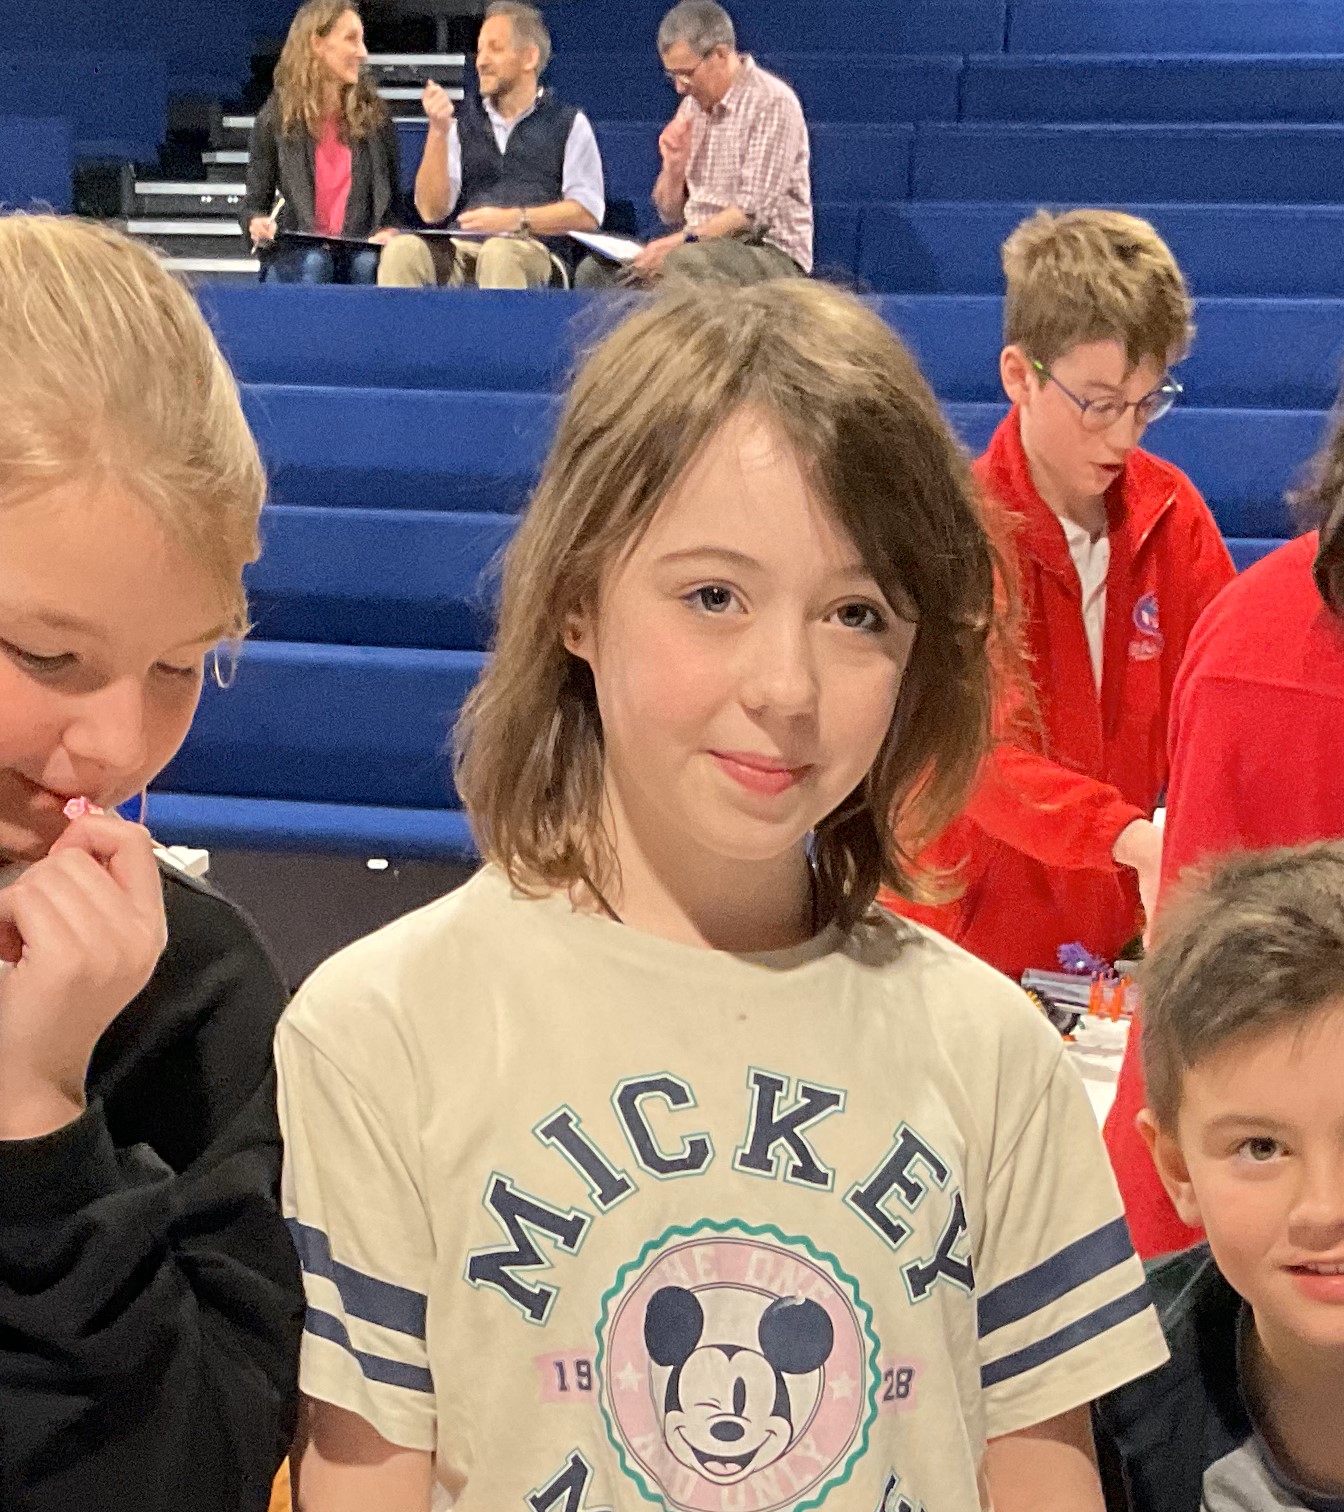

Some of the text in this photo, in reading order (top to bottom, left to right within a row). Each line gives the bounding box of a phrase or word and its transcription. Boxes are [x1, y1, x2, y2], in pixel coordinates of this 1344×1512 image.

[466, 1068, 975, 1326] MICKEY
[553, 1359, 915, 1402] 19 28
